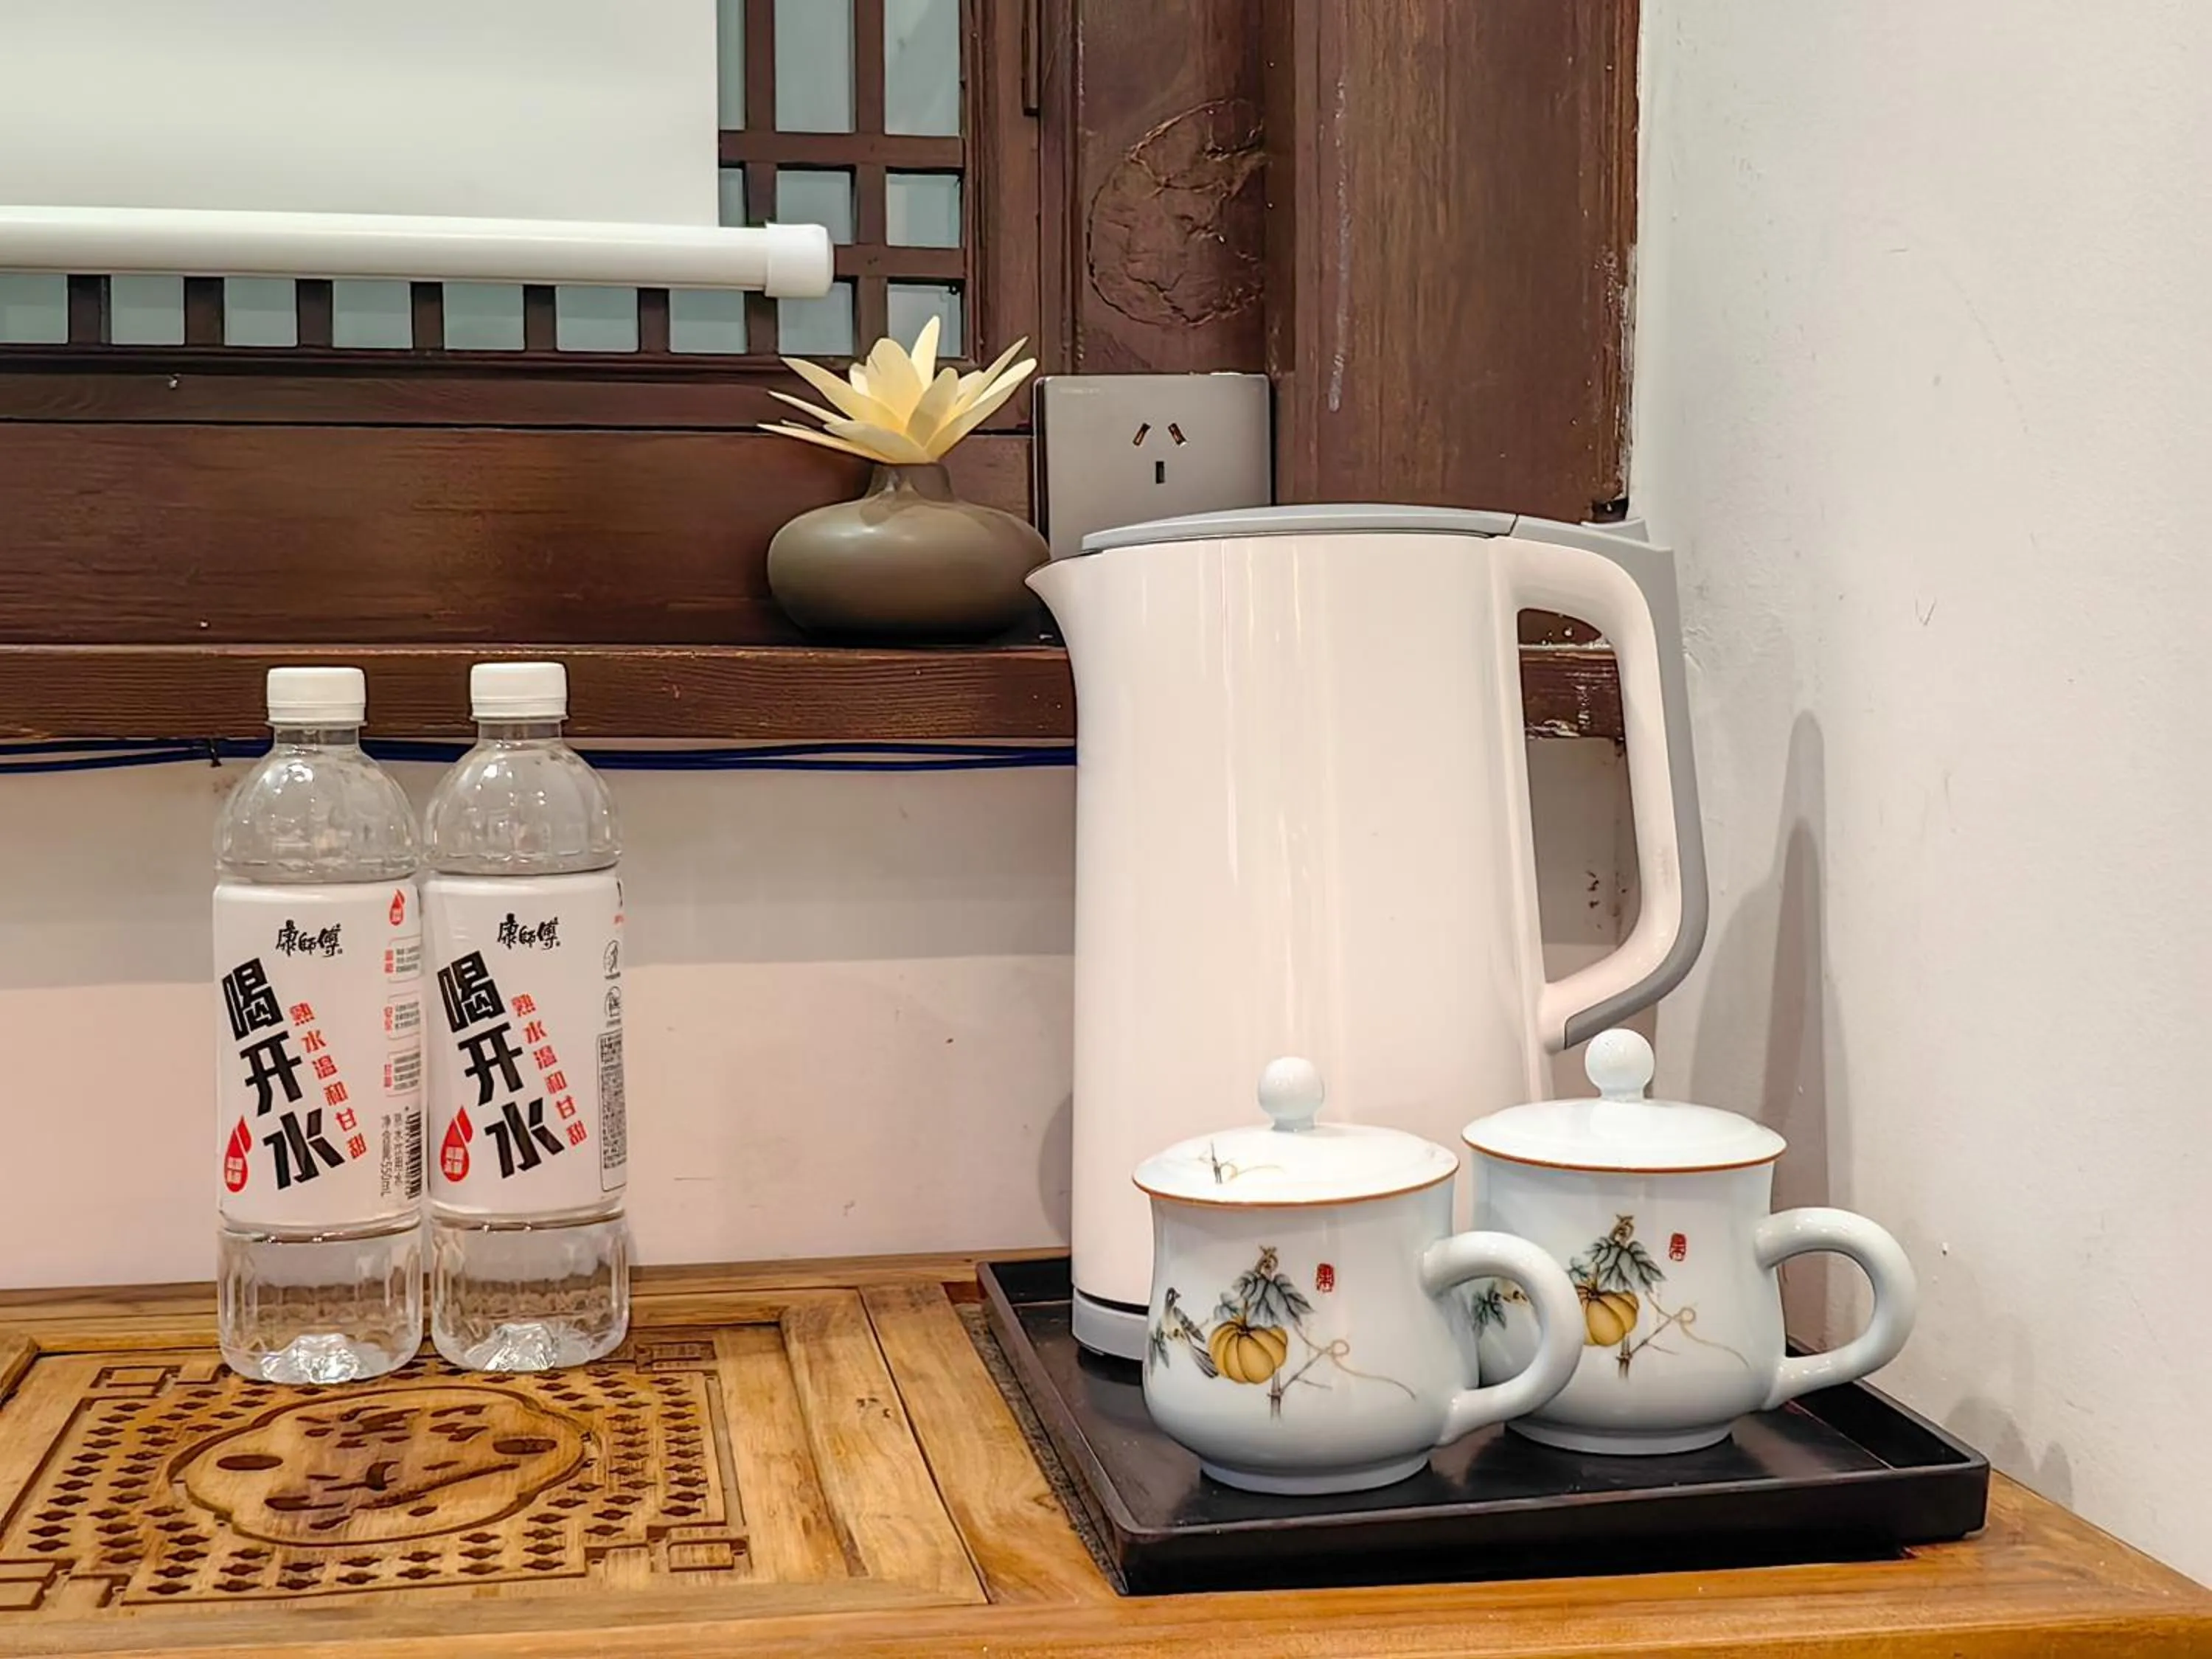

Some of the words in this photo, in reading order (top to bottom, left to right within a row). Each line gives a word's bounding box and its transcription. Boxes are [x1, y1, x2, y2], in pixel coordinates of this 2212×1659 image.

[221, 957, 346, 1190] 喝开水
[437, 950, 566, 1180] 喝开水
